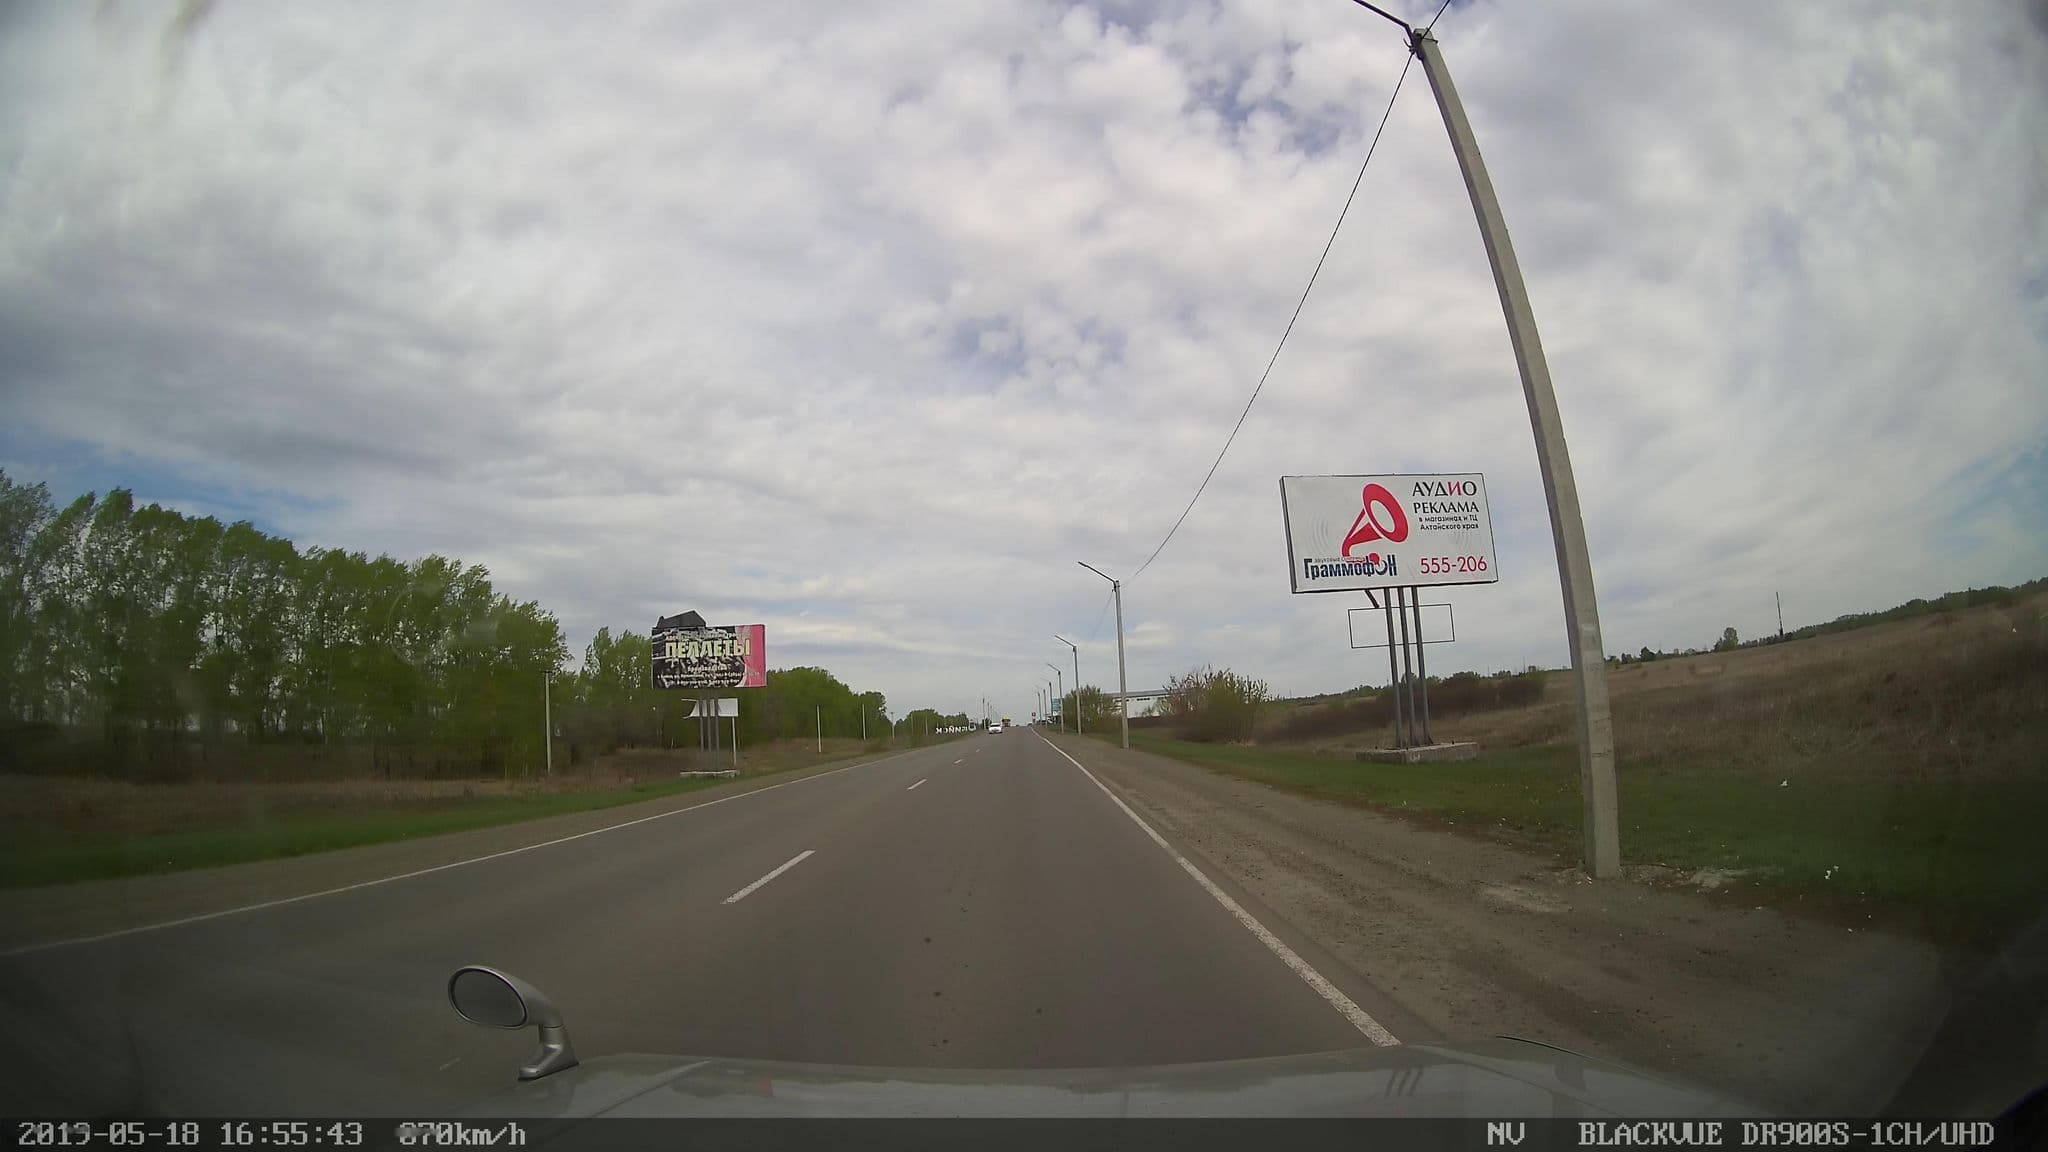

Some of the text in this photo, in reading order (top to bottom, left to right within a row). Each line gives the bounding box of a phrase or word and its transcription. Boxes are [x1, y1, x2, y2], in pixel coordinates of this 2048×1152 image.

[1412, 481, 1477, 496] АУДИО
[1413, 501, 1479, 514] РЕКЛАМА
[1420, 522, 1461, 530] Алтайского
[1420, 556, 1487, 574] 555-206
[665, 639, 750, 658] ПЕЛЛЕТЫ
